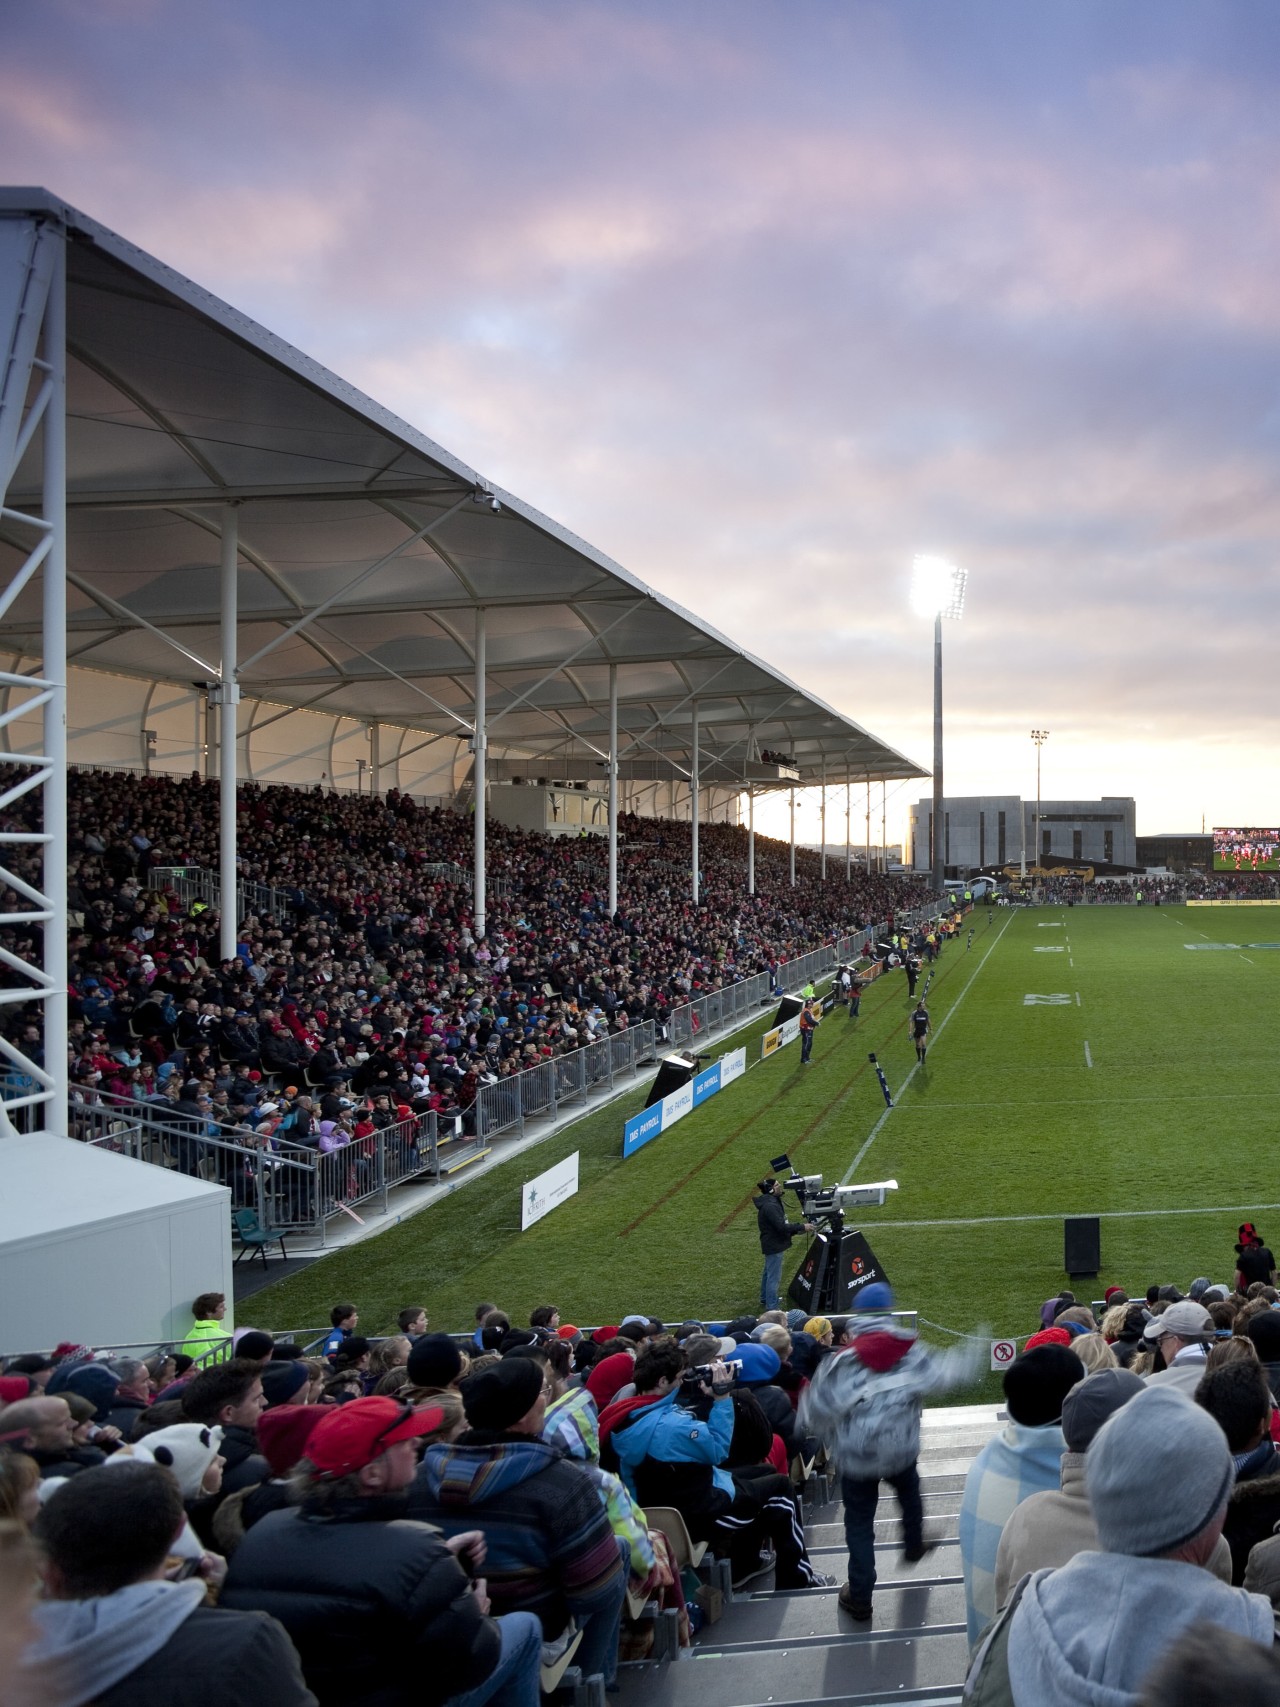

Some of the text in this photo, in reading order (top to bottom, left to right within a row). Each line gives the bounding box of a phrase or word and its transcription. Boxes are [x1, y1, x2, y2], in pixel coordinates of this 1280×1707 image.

[696, 1074, 719, 1095] IMS PAYROLL
[665, 1094, 691, 1117] IMS PAYROLL
[629, 1114, 660, 1143] IMS PAYROLL
